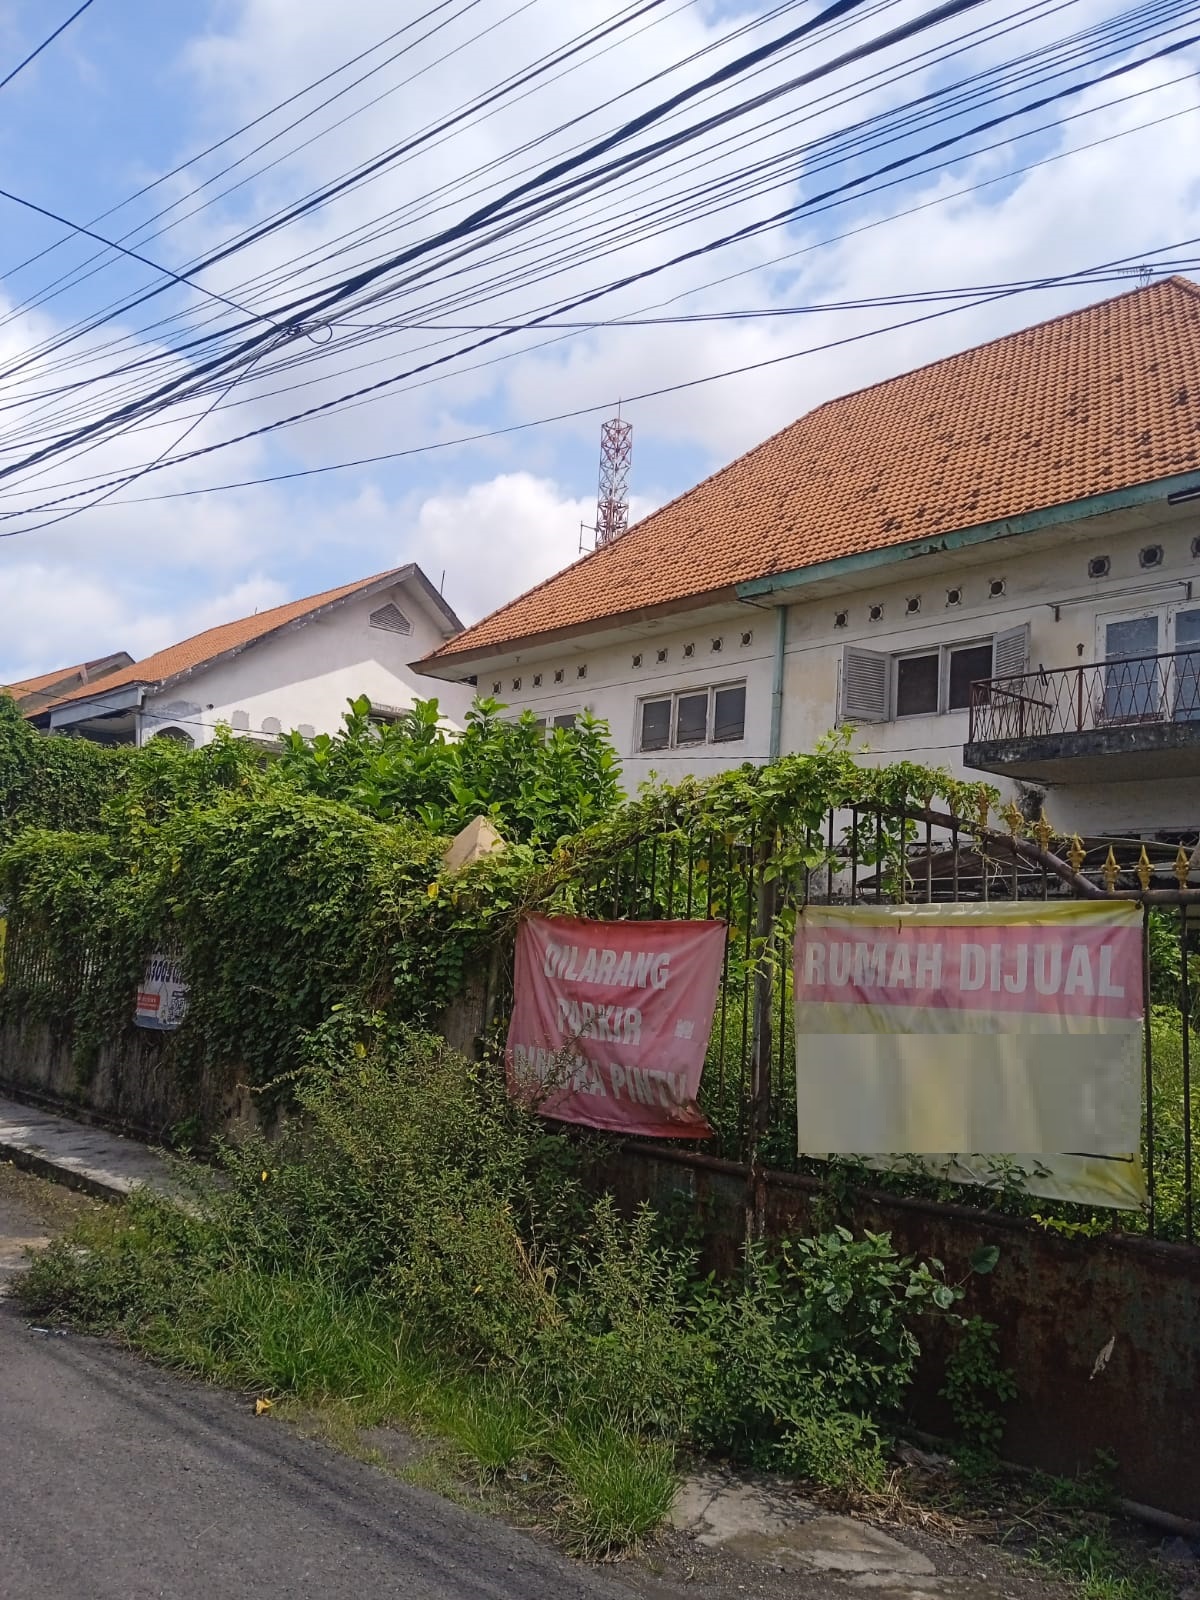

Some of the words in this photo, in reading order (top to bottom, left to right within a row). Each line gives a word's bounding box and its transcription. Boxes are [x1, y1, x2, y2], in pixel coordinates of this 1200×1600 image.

[544, 943, 672, 990] DILARANG
[803, 941, 943, 990] RUMAH
[959, 943, 1126, 999] DIJUAL
[556, 998, 642, 1046] PARKIR
[609, 1063, 687, 1108] PINTU
